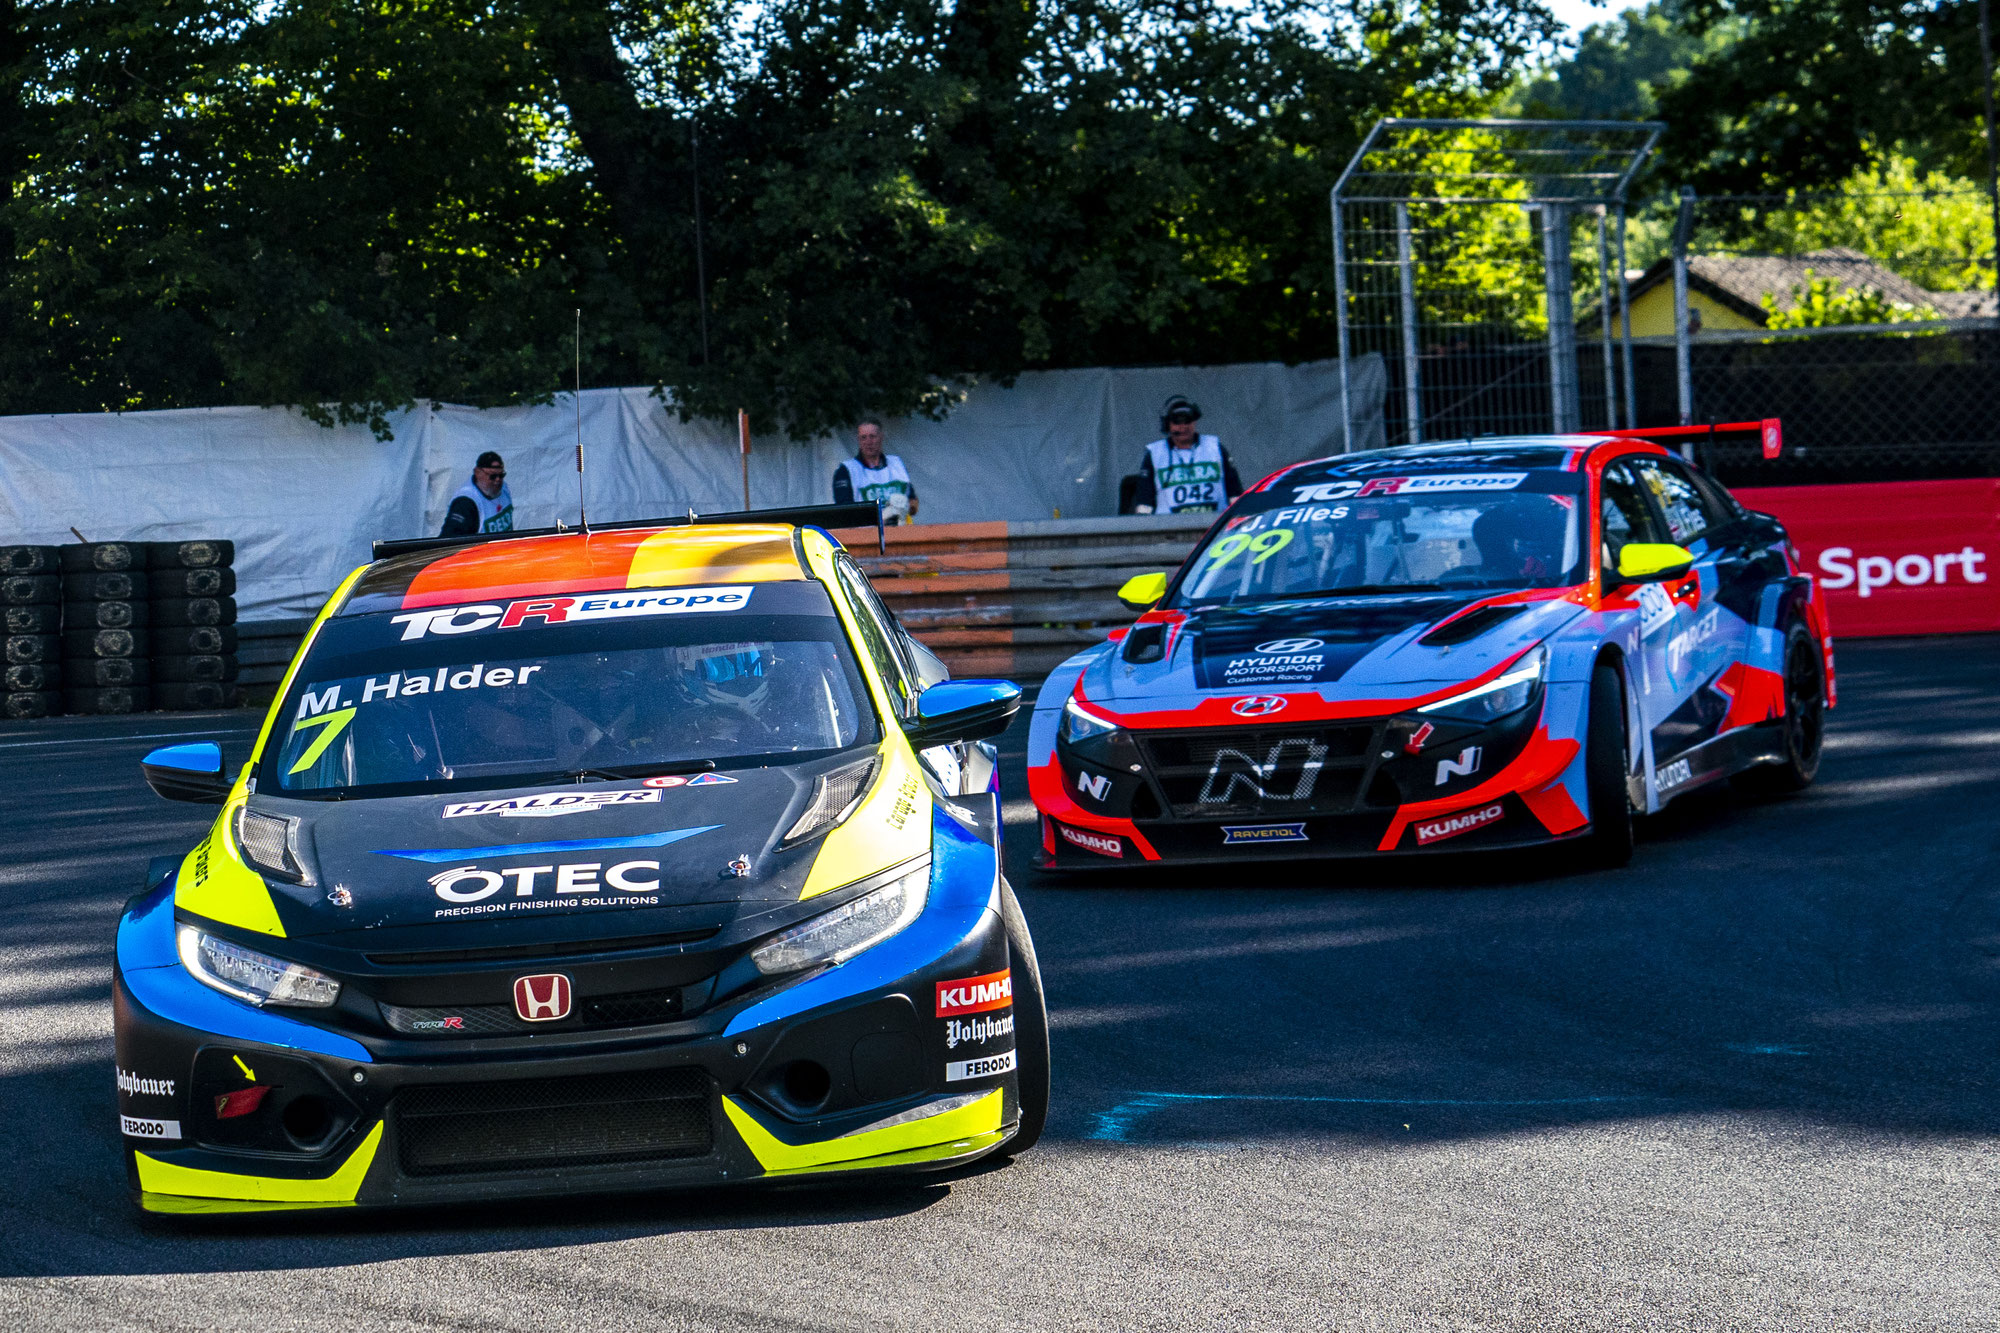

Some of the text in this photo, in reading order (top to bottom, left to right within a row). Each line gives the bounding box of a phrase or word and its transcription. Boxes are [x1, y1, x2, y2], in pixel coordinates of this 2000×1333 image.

[1173, 483, 1215, 504] 042
[1293, 477, 1518, 503] TCR Europe
[1240, 506, 1350, 533] J. Files
[1206, 528, 1295, 572] 99
[1818, 546, 1987, 598] Sport
[390, 593, 744, 642] TCR Europe
[1224, 664, 1326, 677] MOTORSPORT
[1226, 673, 1313, 684] Customer Racing
[297, 663, 542, 719] M. Halder
[288, 706, 358, 776] 7
[452, 791, 652, 815] HALDER
[1232, 828, 1297, 839] RAVENOL
[1417, 805, 1502, 839] KUMHO
[1060, 826, 1122, 853] KUMHO
[427, 860, 661, 903] OTEC
[434, 895, 659, 918] PRECISION FINISHING SOLUTIONS
[965, 1056, 1011, 1077] FERODO
[124, 1118, 164, 1136] FERODO
